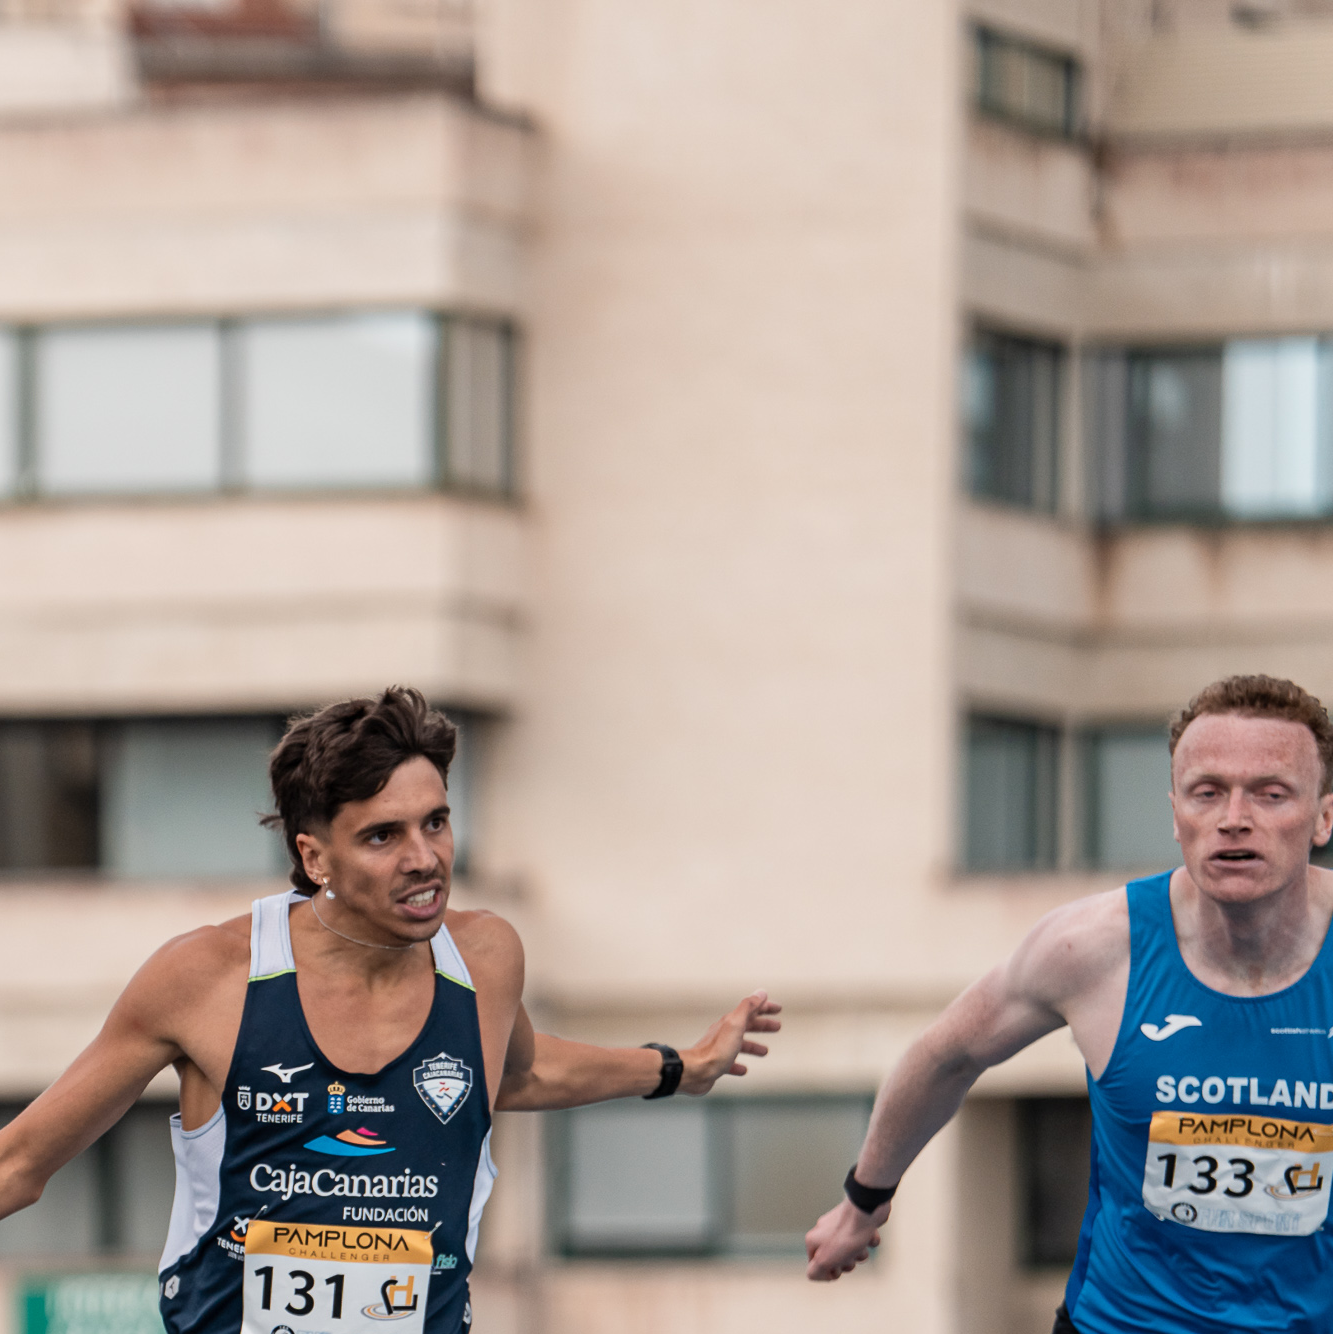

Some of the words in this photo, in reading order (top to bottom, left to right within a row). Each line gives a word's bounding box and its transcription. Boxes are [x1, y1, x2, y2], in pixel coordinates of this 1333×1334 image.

[346, 1095, 385, 1105] Gobierno
[1155, 1075, 1333, 1110] SCOTLAND
[256, 1113, 304, 1124] TENERIFE
[346, 1104, 357, 1113] de
[358, 1104, 396, 1113] Canarias
[1179, 1118, 1315, 1143] PAMPLONA
[1193, 1136, 1295, 1149] CHALLENGER
[249, 1163, 439, 1200] CajaCanarias
[1157, 1153, 1255, 1198] 133
[343, 1206, 429, 1222] FUNDACIÓN
[274, 1227, 410, 1251] PAMPLONA
[289, 1247, 390, 1261] CHALLENGER
[254, 1265, 345, 1319] 131
